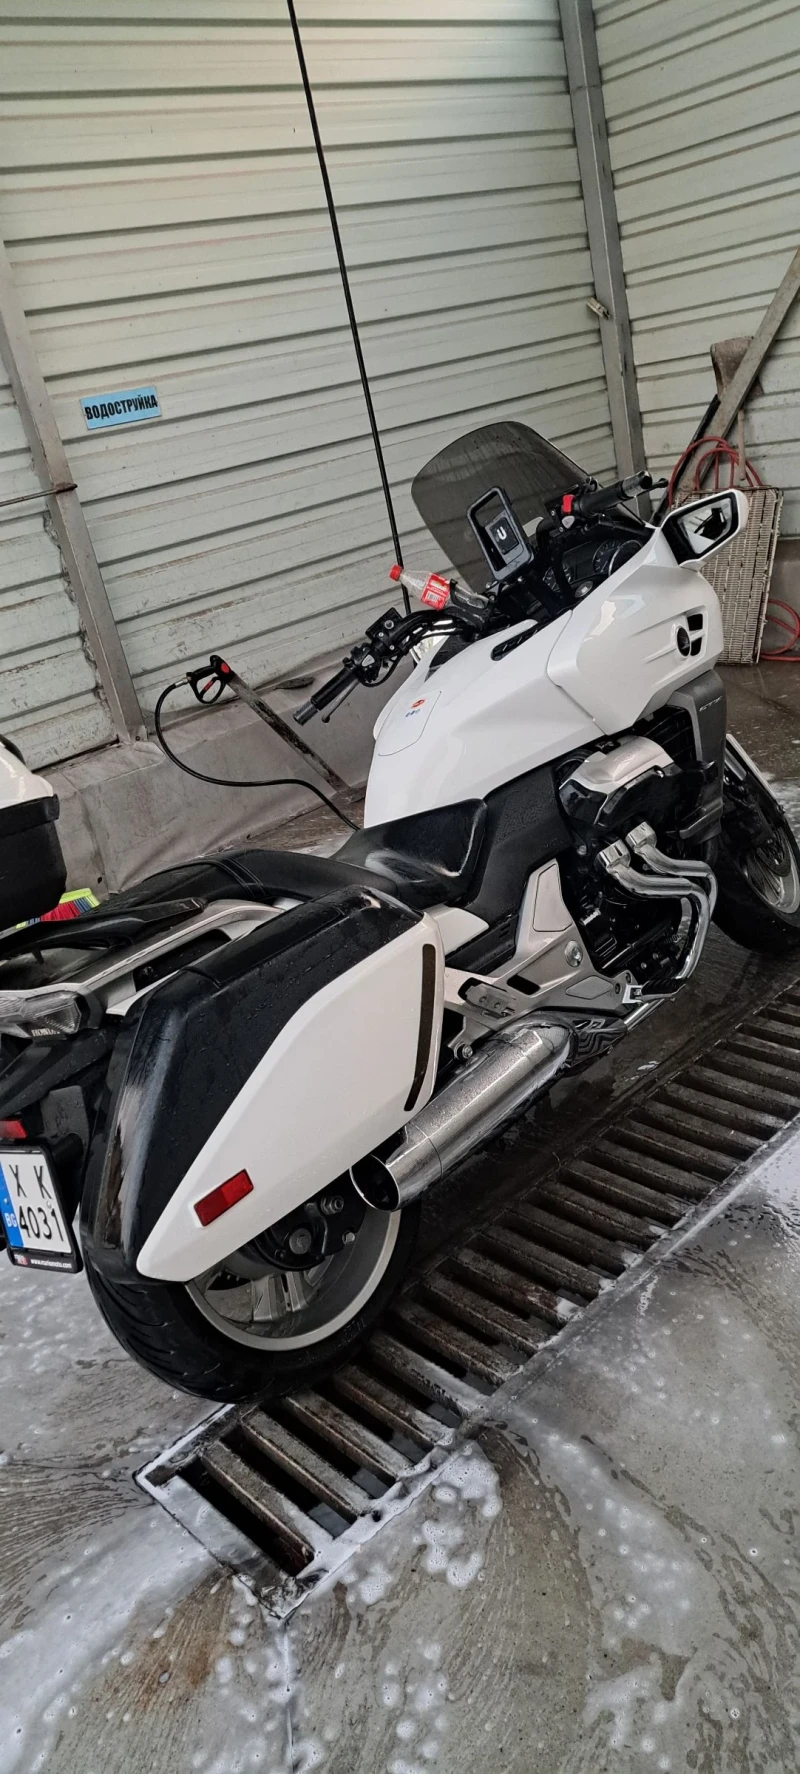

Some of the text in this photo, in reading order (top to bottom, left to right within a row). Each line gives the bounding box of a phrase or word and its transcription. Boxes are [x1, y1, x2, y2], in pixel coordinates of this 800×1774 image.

[84, 394, 158, 420] ВОДОСТРУЙКА
[5, 1212, 17, 1227] BG
[18, 1205, 64, 1242] 4031
